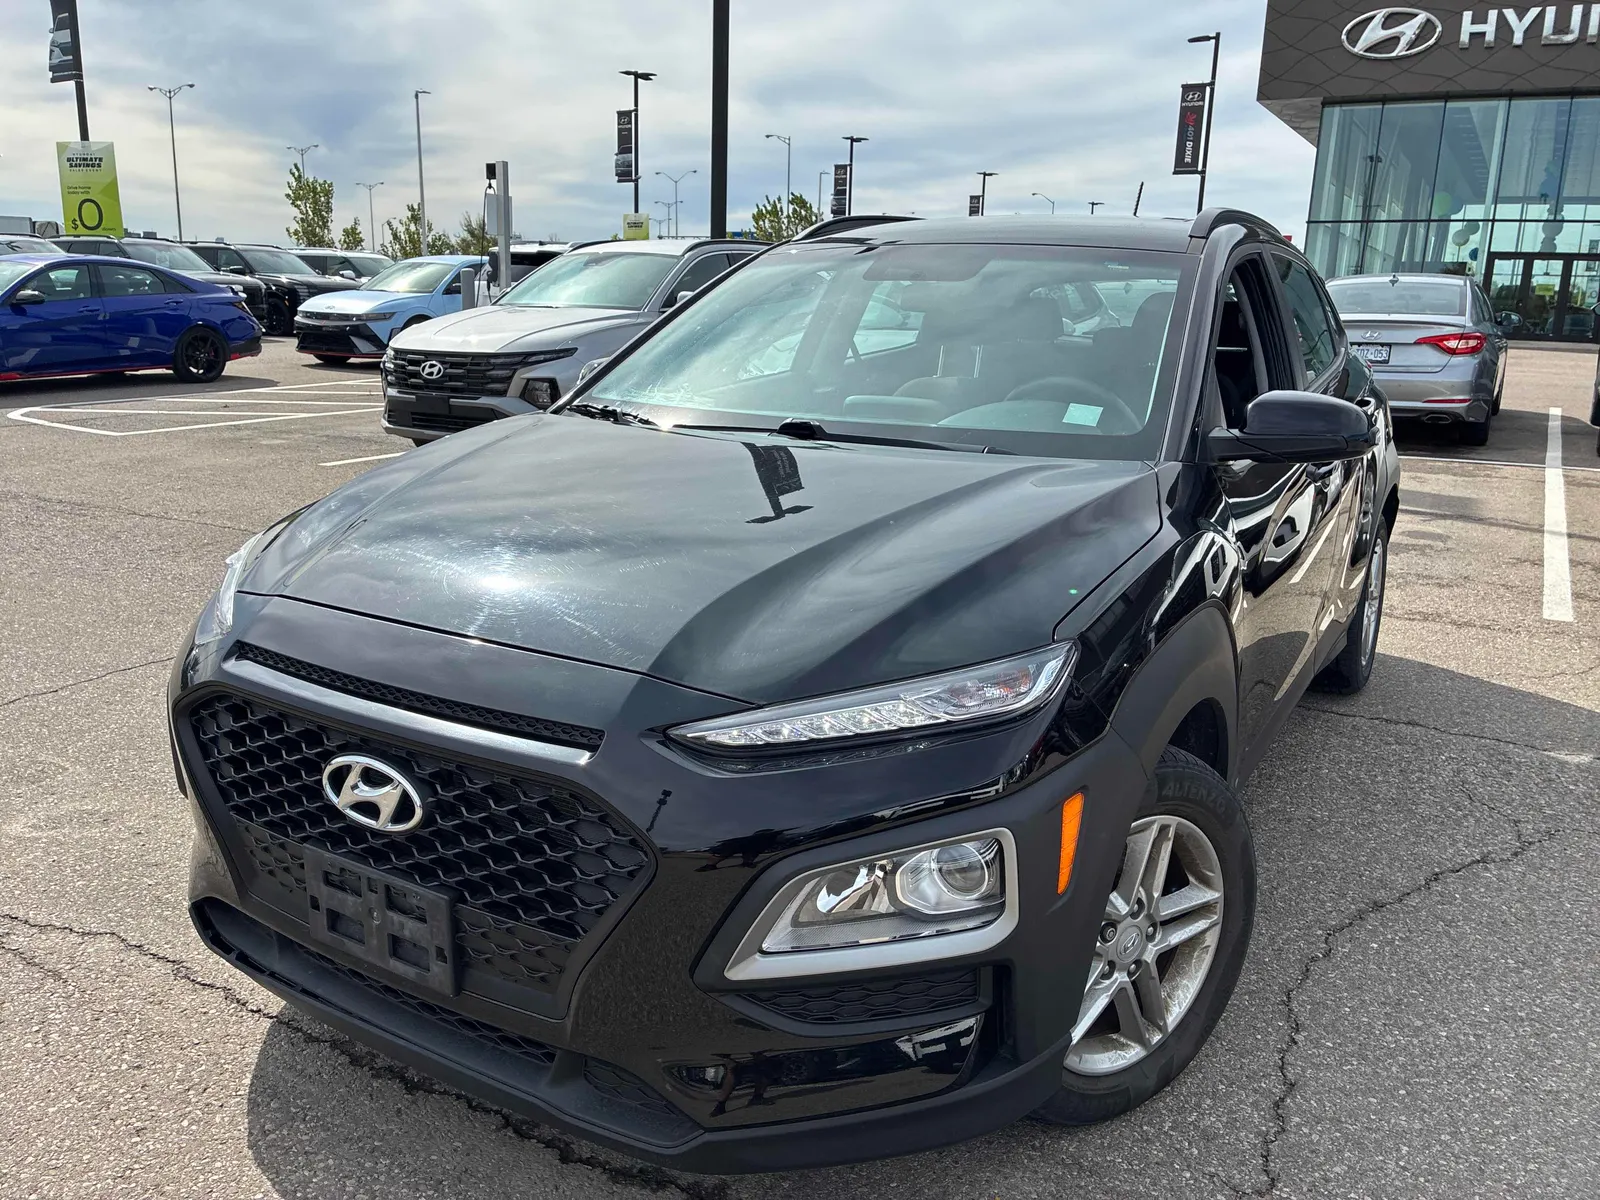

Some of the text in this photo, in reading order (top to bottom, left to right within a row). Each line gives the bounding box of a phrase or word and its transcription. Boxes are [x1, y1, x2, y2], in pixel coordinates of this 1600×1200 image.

[1184, 142, 1193, 164] DIXIE
[1356, 349, 1369, 358] TDZ
[1162, 782, 1226, 813] ALTENZO
